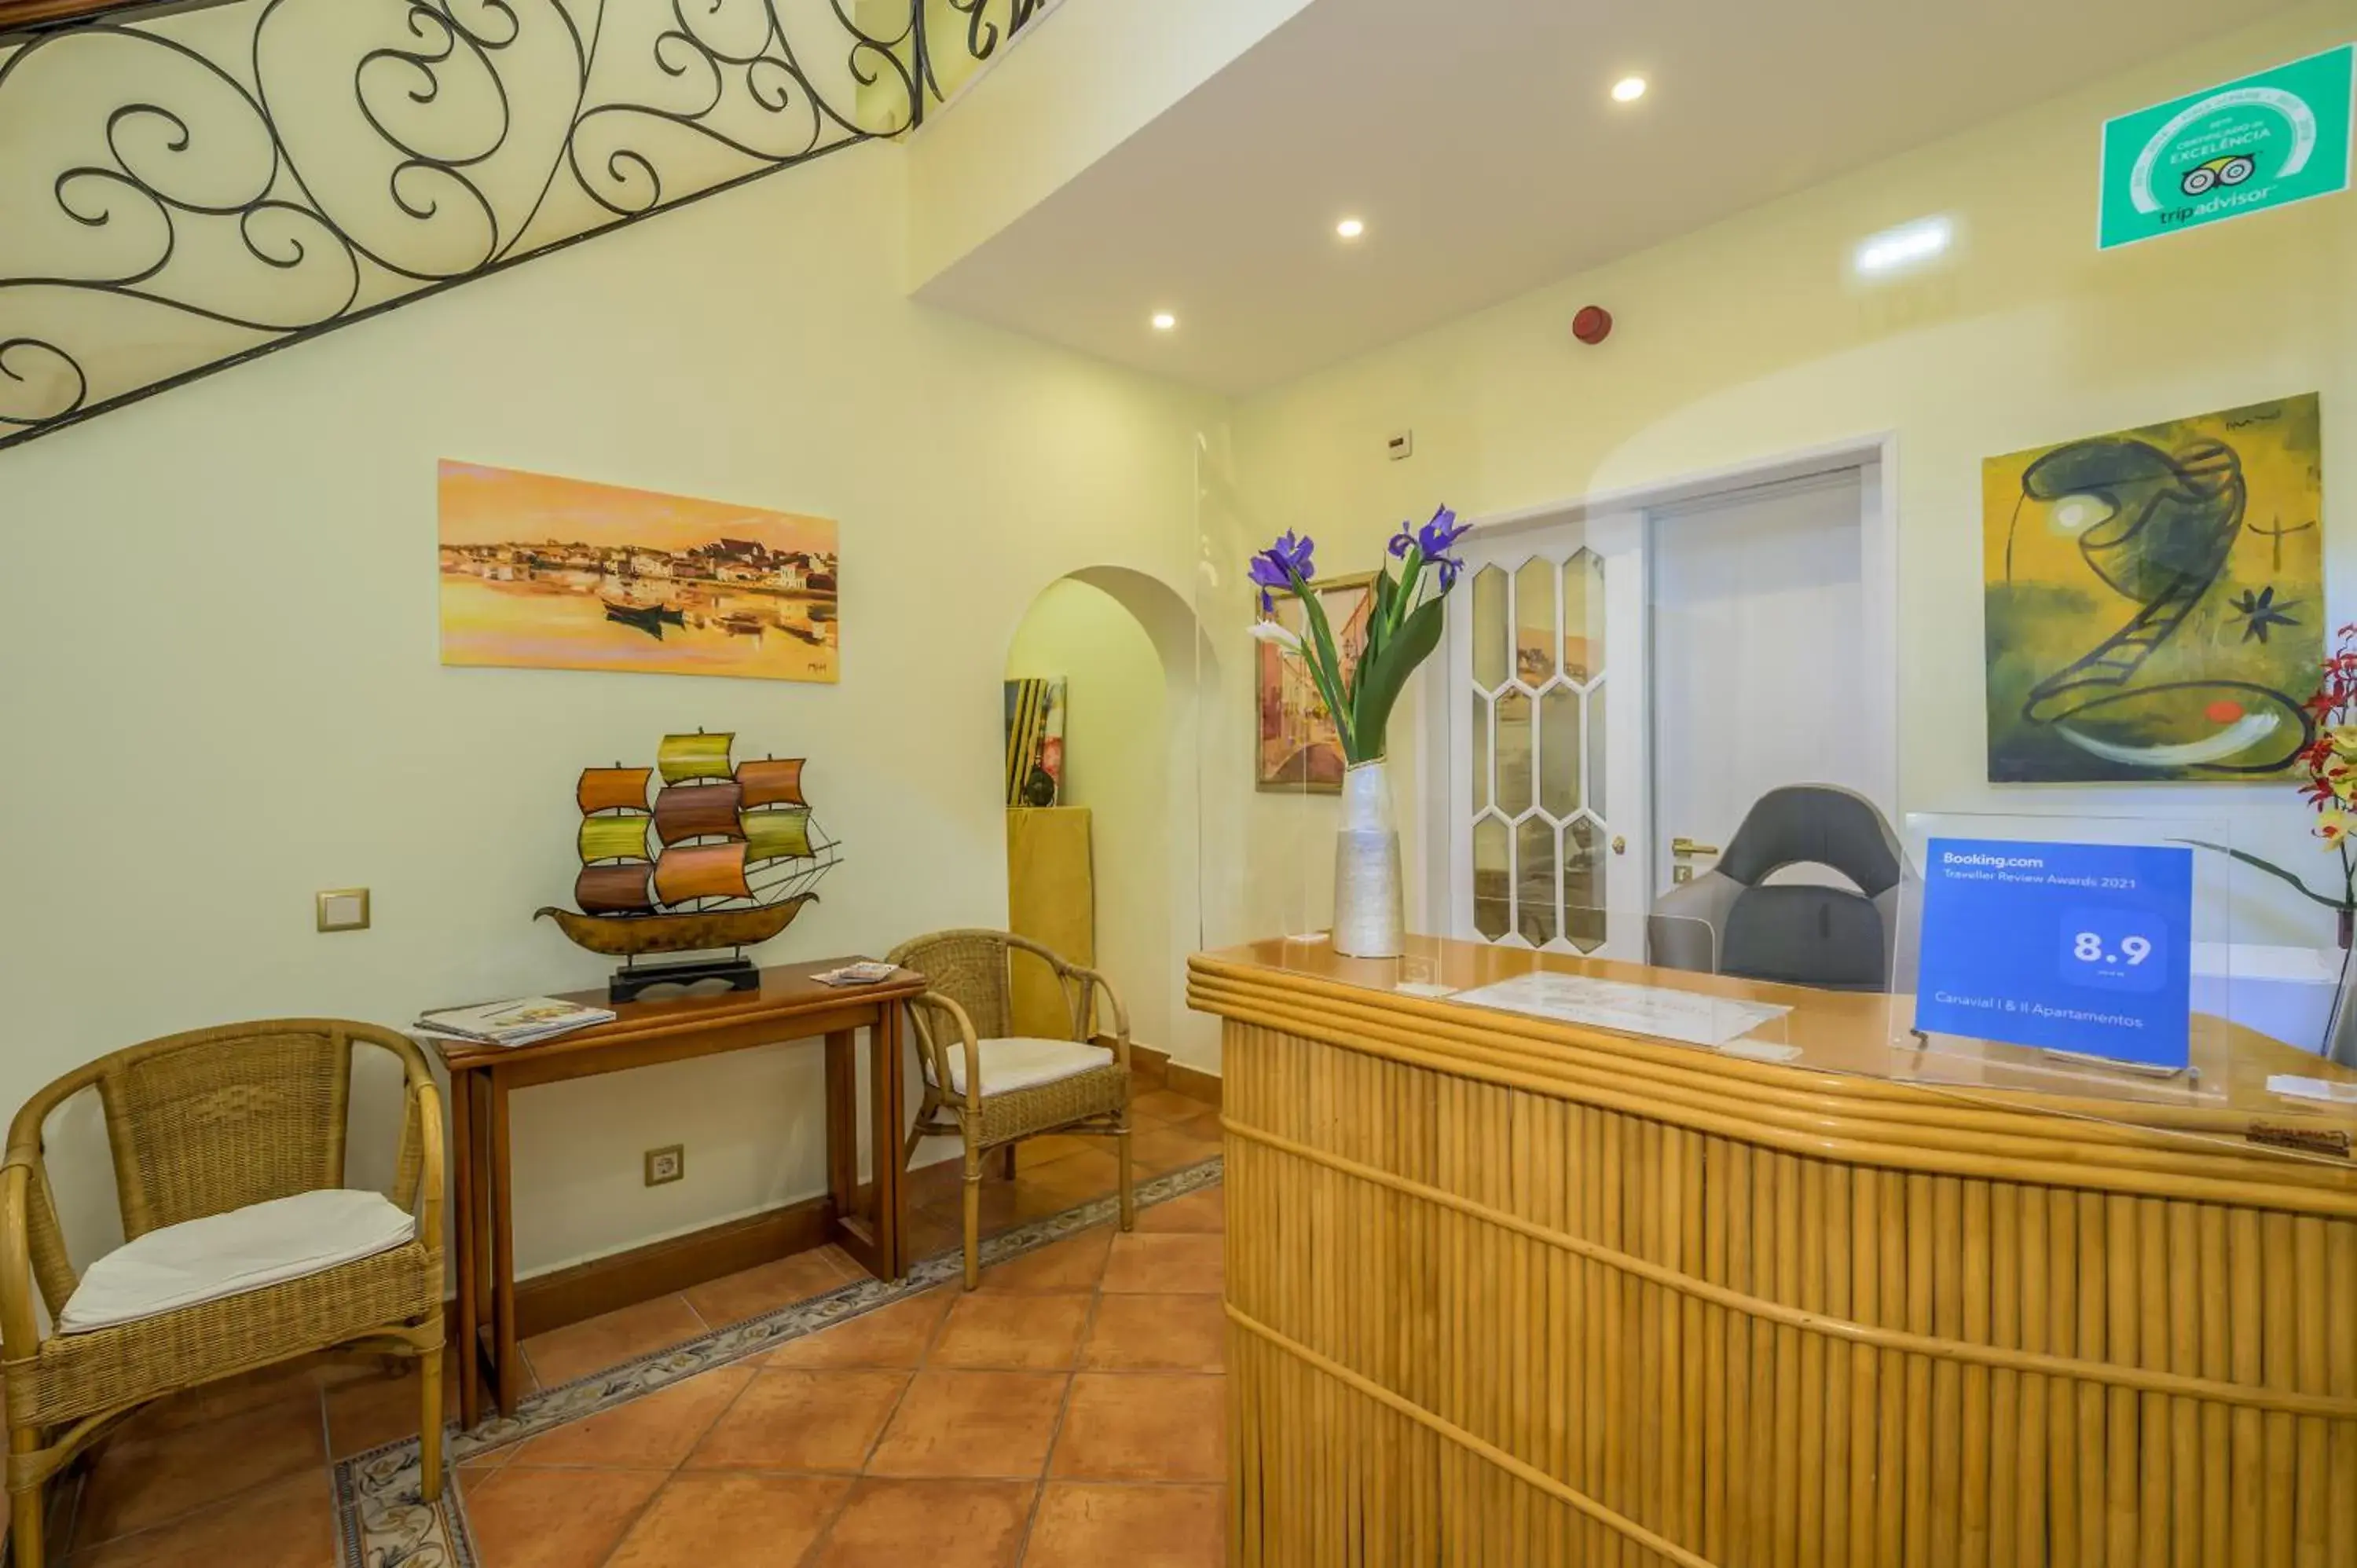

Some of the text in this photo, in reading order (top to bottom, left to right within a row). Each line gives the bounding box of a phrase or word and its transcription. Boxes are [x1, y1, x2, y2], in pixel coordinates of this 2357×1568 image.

[2170, 128, 2271, 164] EXCELÊNCIA
[2161, 189, 2269, 223] tripadvisor
[1944, 852, 2043, 868] Booking.com
[1944, 869, 2135, 888] Traveller Review Awards 2021
[2073, 932, 2151, 965] 8.9
[1935, 991, 1994, 1009] Canavial
[2005, 1000, 2016, 1012] &
[2032, 1003, 2144, 1028] Apartamentos
